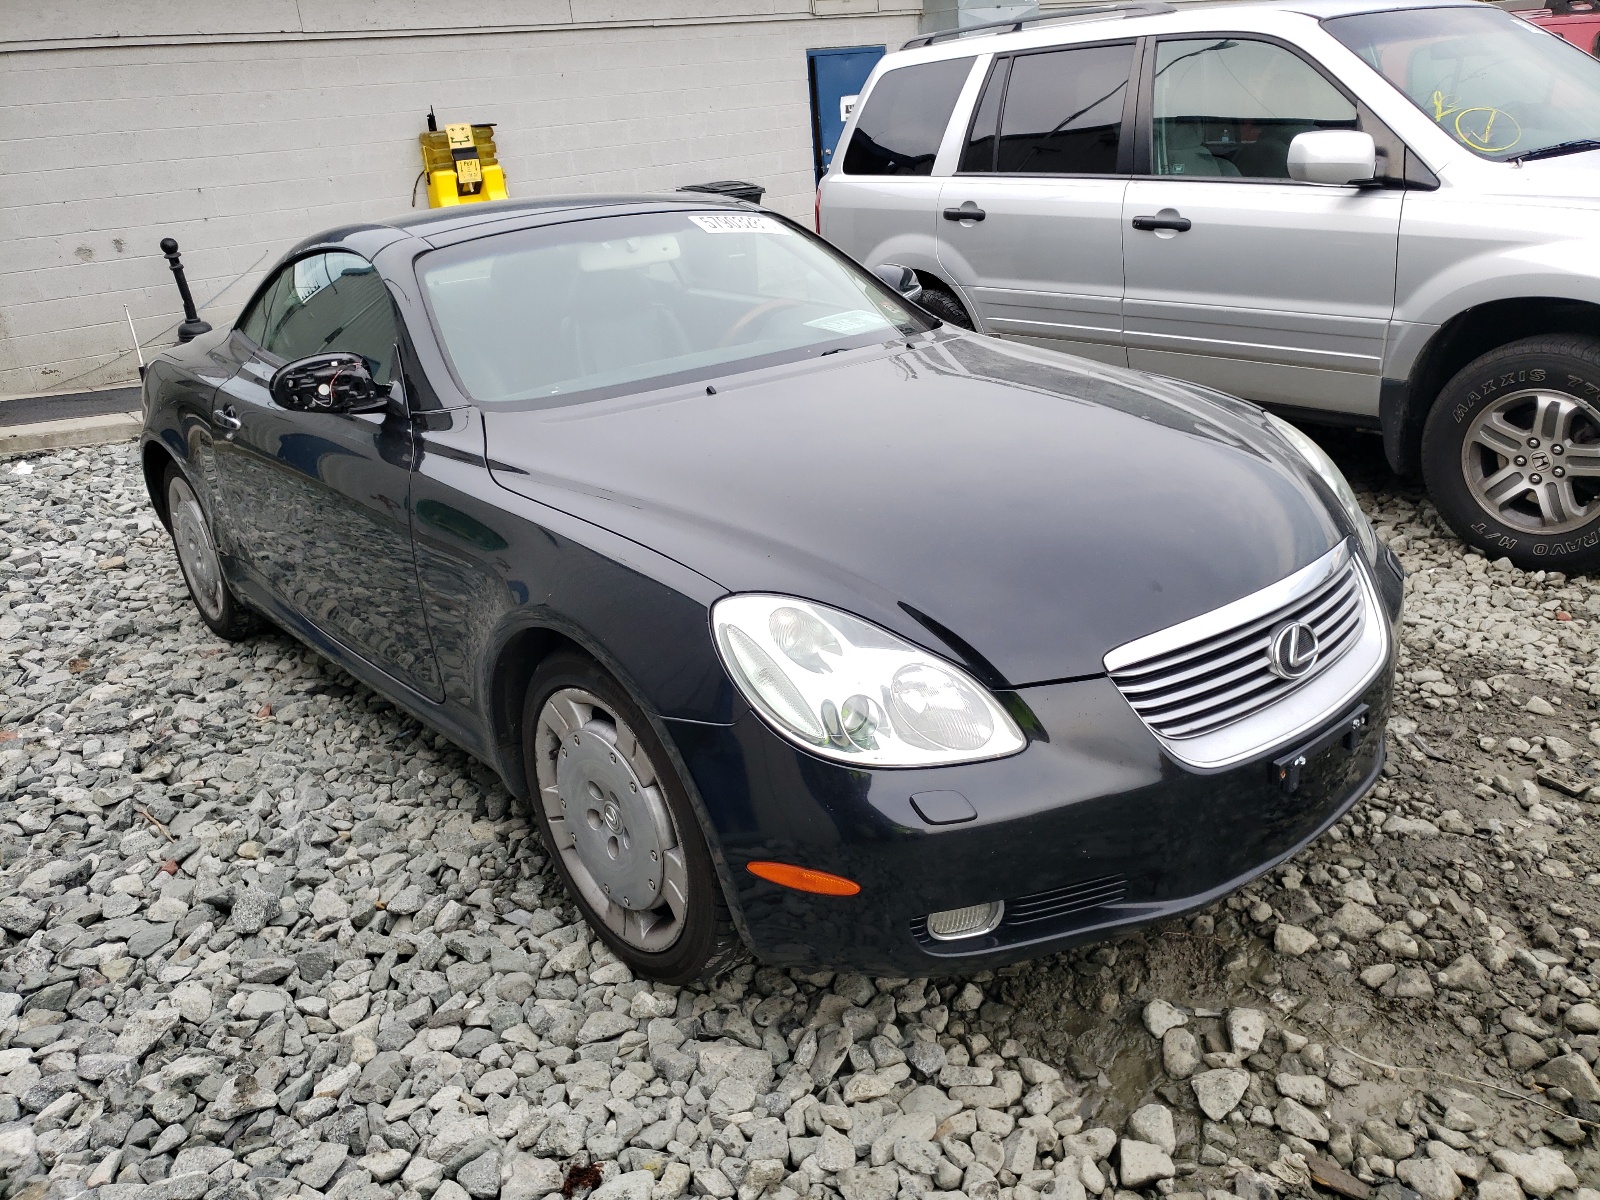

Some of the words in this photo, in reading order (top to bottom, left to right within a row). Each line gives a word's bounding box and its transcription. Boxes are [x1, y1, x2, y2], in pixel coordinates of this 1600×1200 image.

[1453, 368, 1546, 423] MAXXIS
[1567, 374, 1600, 404] 77
[1471, 522, 1518, 550] H/T
[1532, 528, 1600, 556] RAVO
